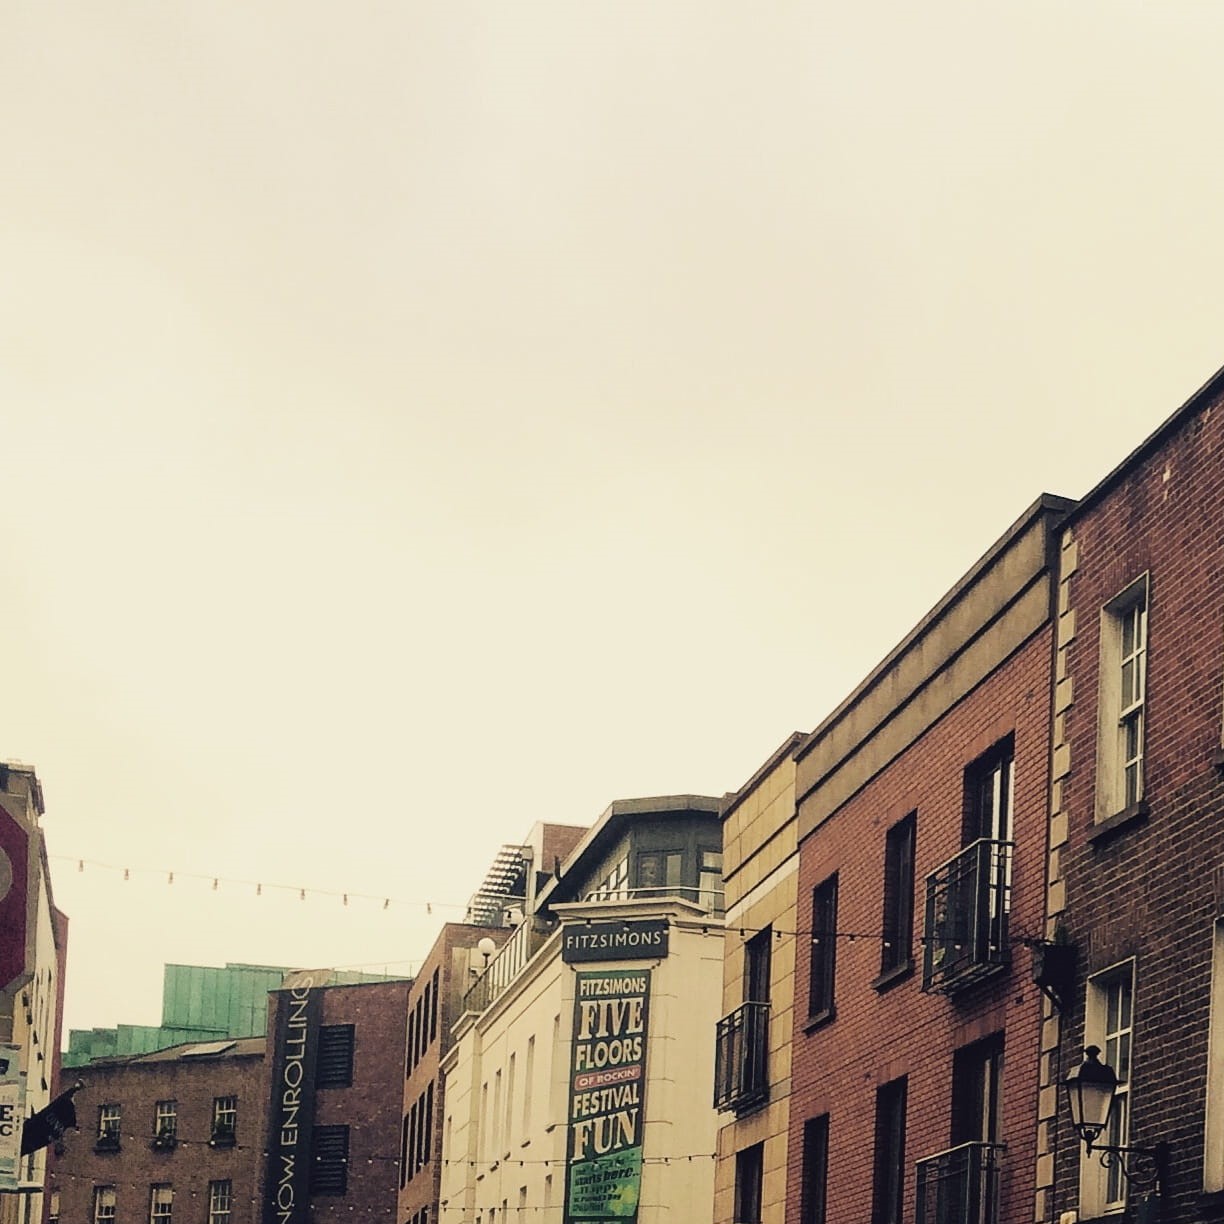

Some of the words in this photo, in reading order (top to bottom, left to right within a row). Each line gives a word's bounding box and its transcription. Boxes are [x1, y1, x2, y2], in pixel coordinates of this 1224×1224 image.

[566, 931, 662, 949] FITZSIMONS
[579, 977, 647, 996] FITZSIMONS
[577, 996, 644, 1041] FIVE
[281, 976, 315, 1147] ENROLLING
[575, 1036, 643, 1071] FLOORS
[579, 1076, 594, 1087] OF
[572, 1083, 640, 1119] FESTIVAL
[569, 1107, 639, 1165] FUN
